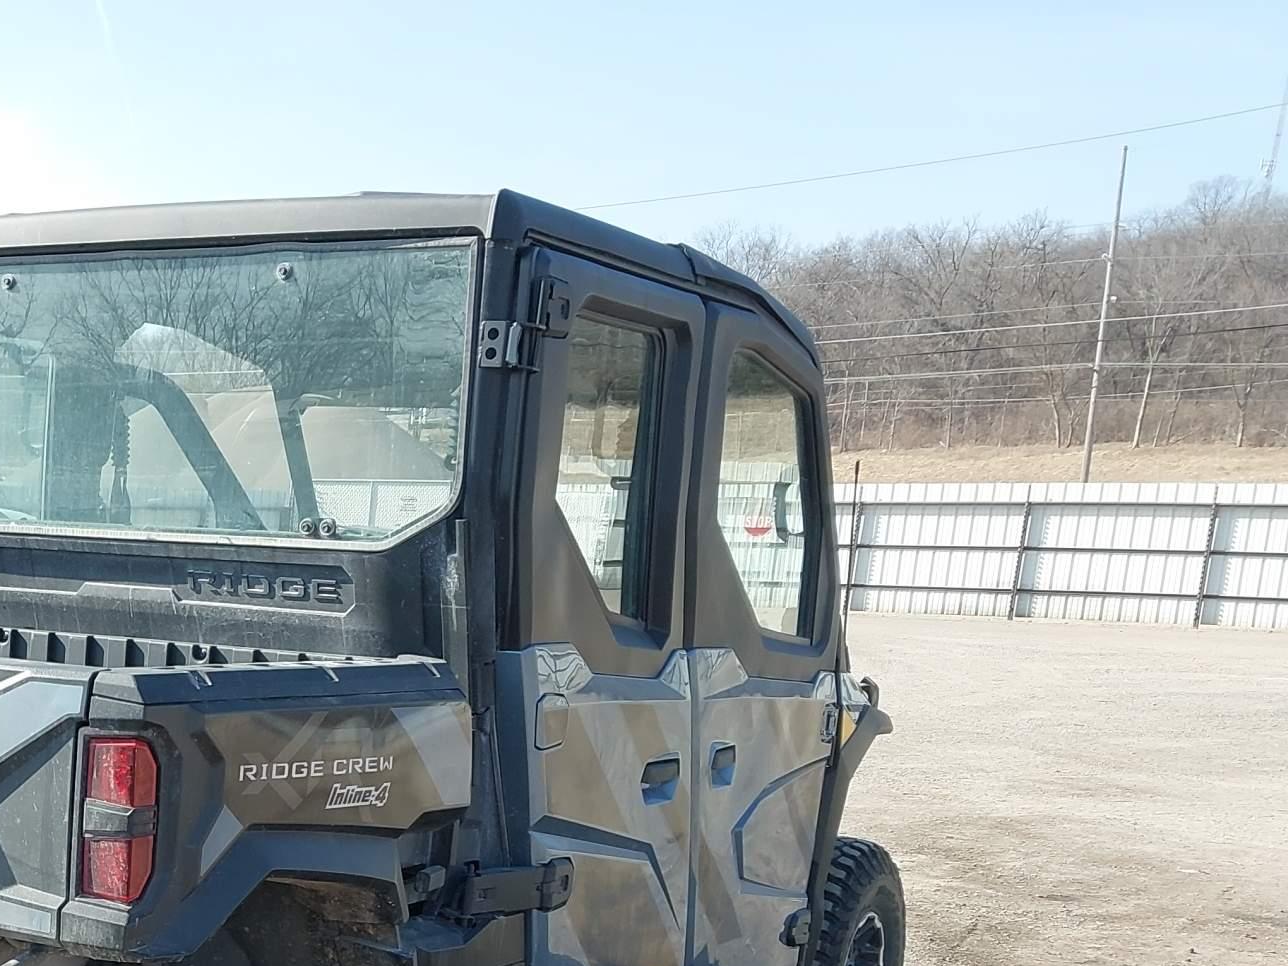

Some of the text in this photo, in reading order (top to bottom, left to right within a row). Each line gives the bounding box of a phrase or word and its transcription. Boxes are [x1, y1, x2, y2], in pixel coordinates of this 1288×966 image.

[745, 516, 772, 527] STOP
[187, 569, 343, 604] RIDGE
[239, 755, 394, 782] RIDGE CREW
